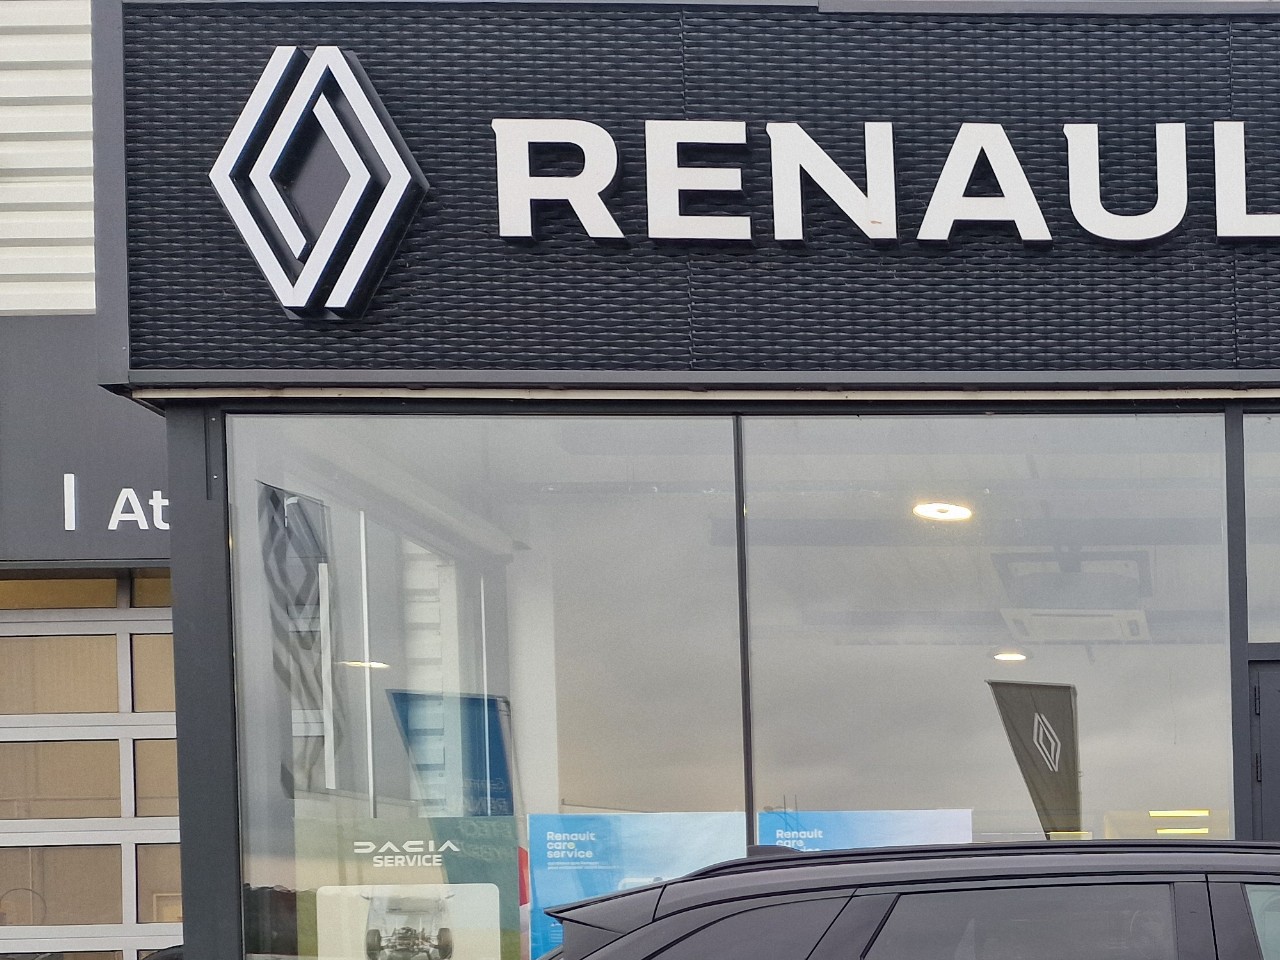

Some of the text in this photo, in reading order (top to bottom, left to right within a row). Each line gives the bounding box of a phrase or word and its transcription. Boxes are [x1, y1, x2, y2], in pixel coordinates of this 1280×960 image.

[107, 487, 170, 531] At
[546, 831, 596, 841] Renault
[775, 829, 824, 839] Renault
[353, 840, 461, 853] DACIA
[546, 842, 576, 850] care
[775, 839, 805, 847] care
[546, 849, 593, 859] service
[372, 854, 443, 868] SERVICE
